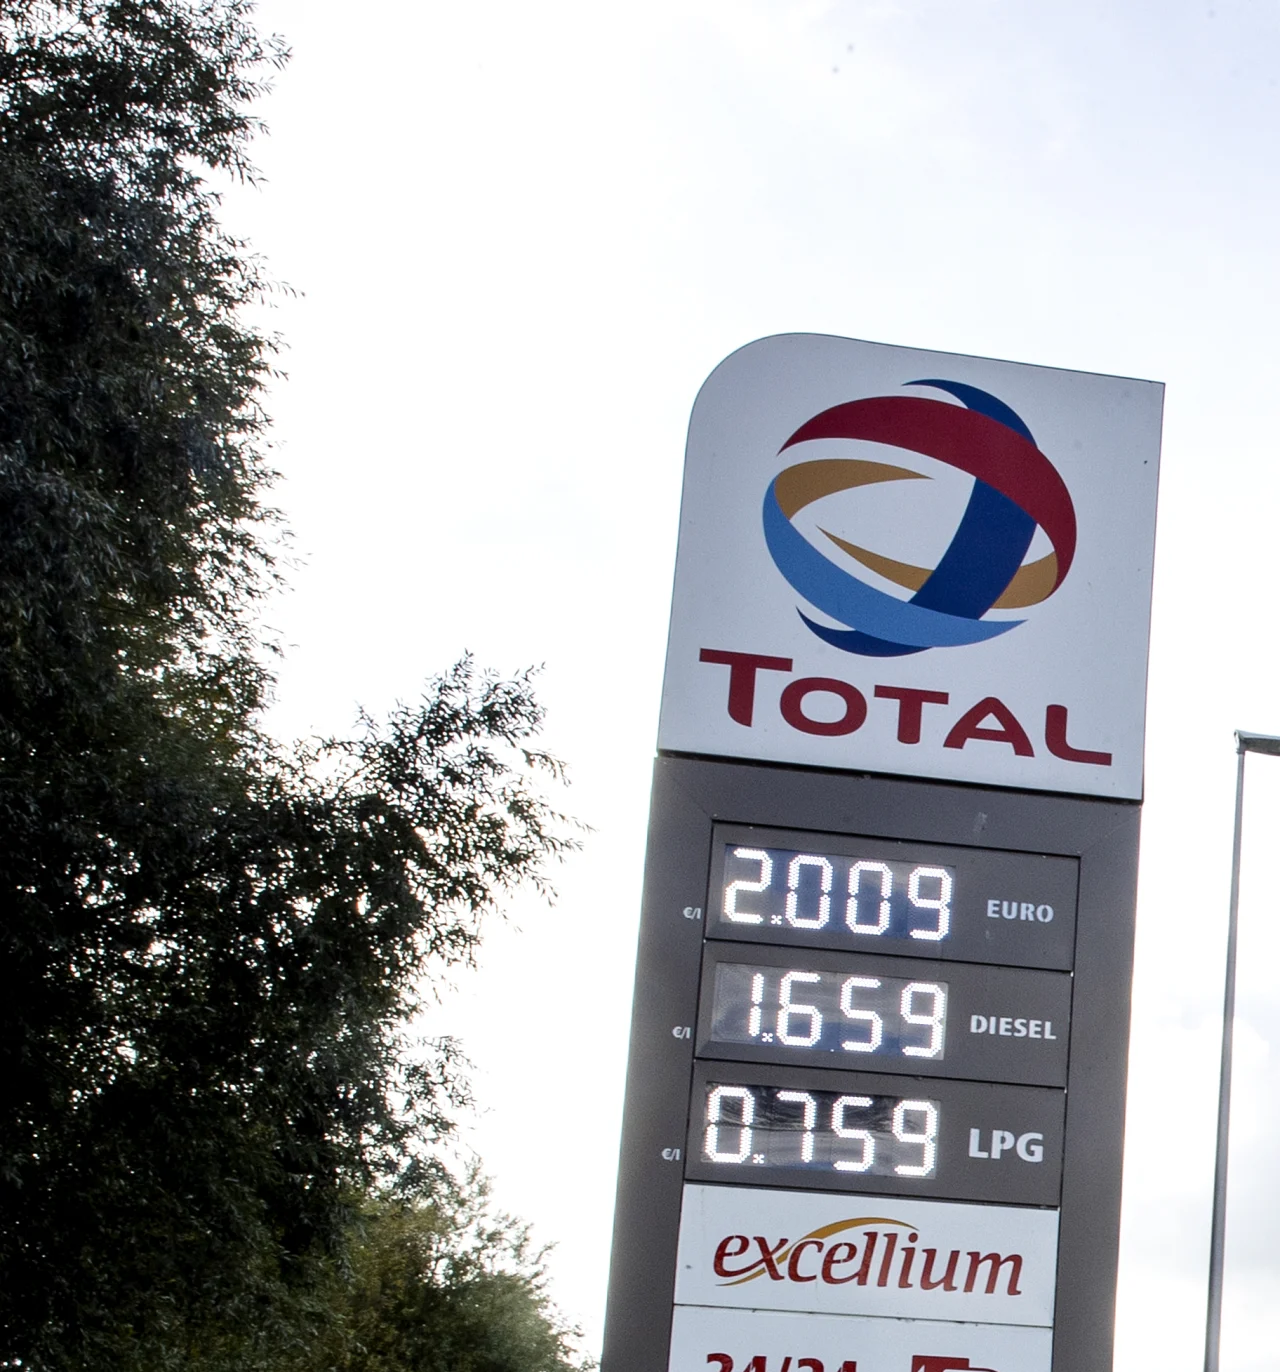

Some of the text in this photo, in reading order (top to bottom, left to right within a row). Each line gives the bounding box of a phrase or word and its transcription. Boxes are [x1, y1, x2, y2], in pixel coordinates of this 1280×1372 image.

[699, 648, 1113, 766] TOTAL
[723, 848, 952, 941] 2.009
[986, 899, 1055, 923] EURO
[751, 972, 946, 1058] 1.659
[969, 1015, 1057, 1040] DIESEL
[704, 1086, 938, 1177] 0.759
[968, 1128, 1044, 1163] LPG
[712, 1230, 1024, 1296] excellium
